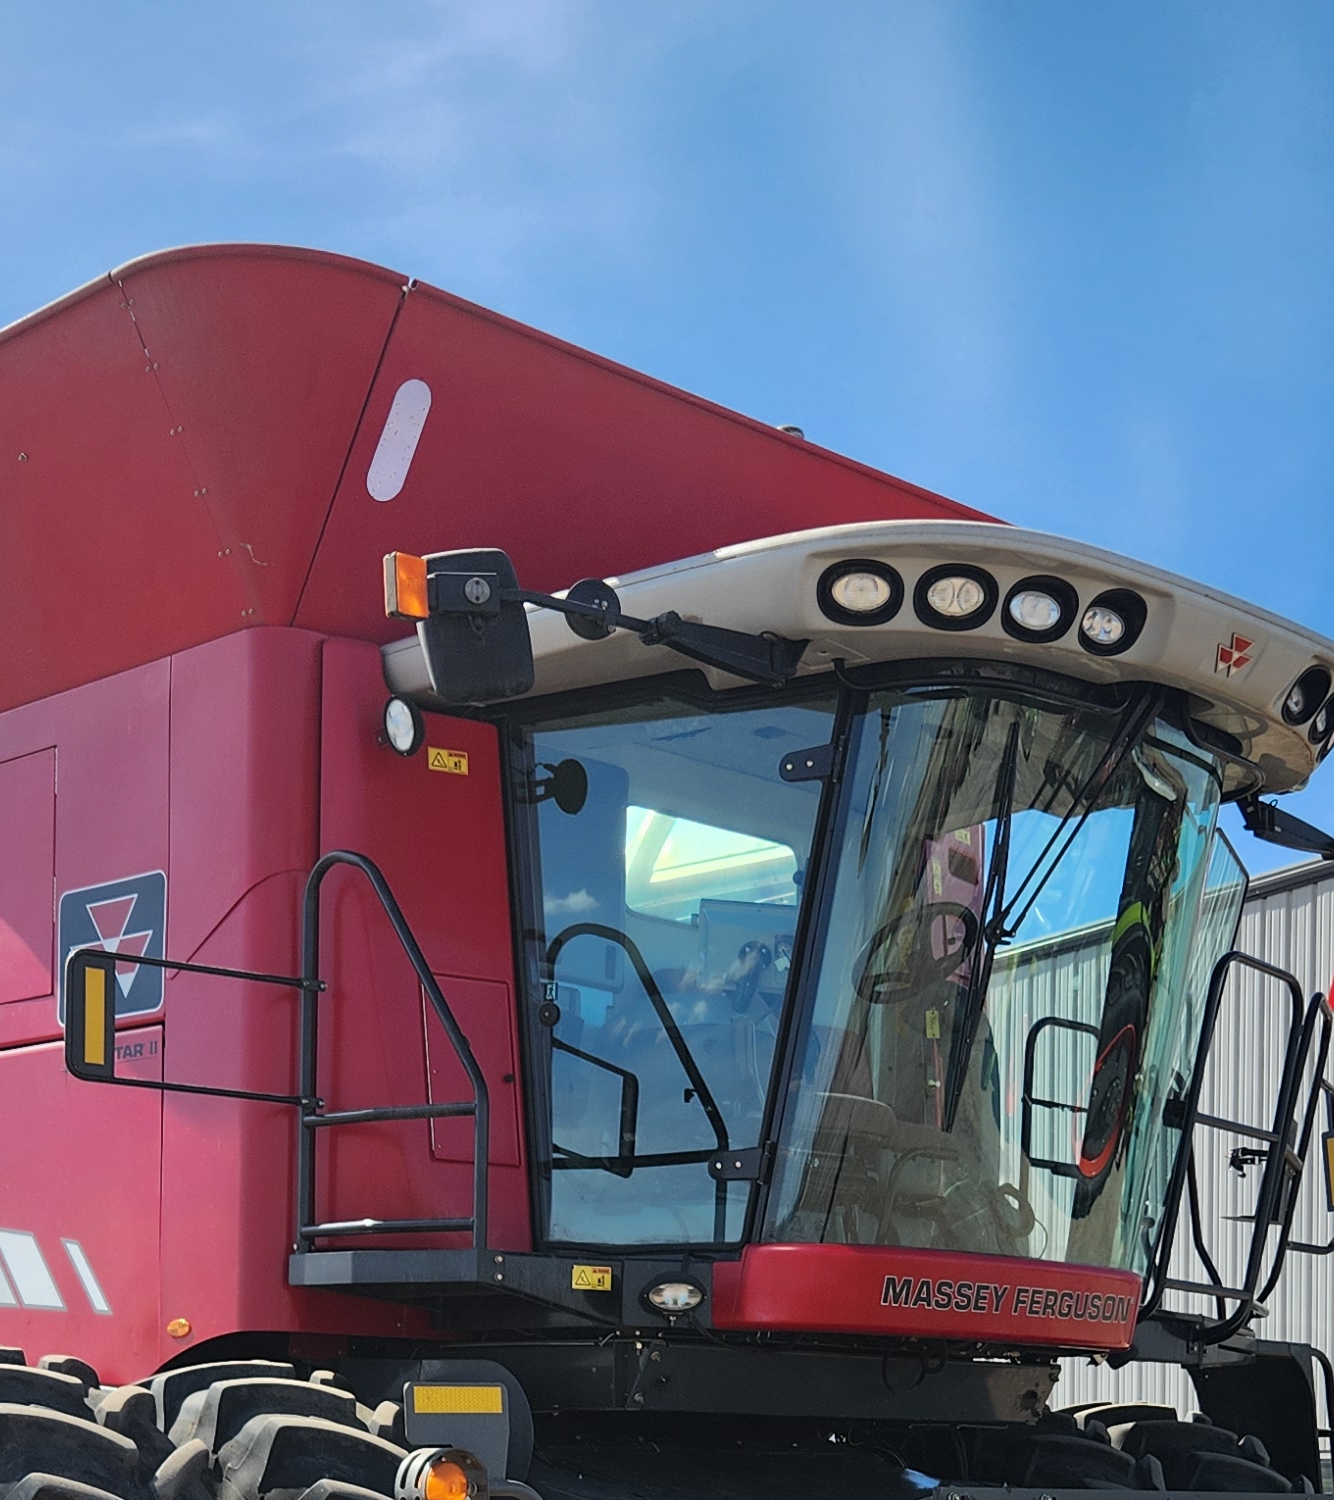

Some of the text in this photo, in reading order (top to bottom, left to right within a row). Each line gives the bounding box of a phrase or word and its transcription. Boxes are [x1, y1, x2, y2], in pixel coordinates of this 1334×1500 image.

[114, 1043, 144, 1059] TAR
[881, 1276, 1130, 1325] MASSEY FERGUSON
